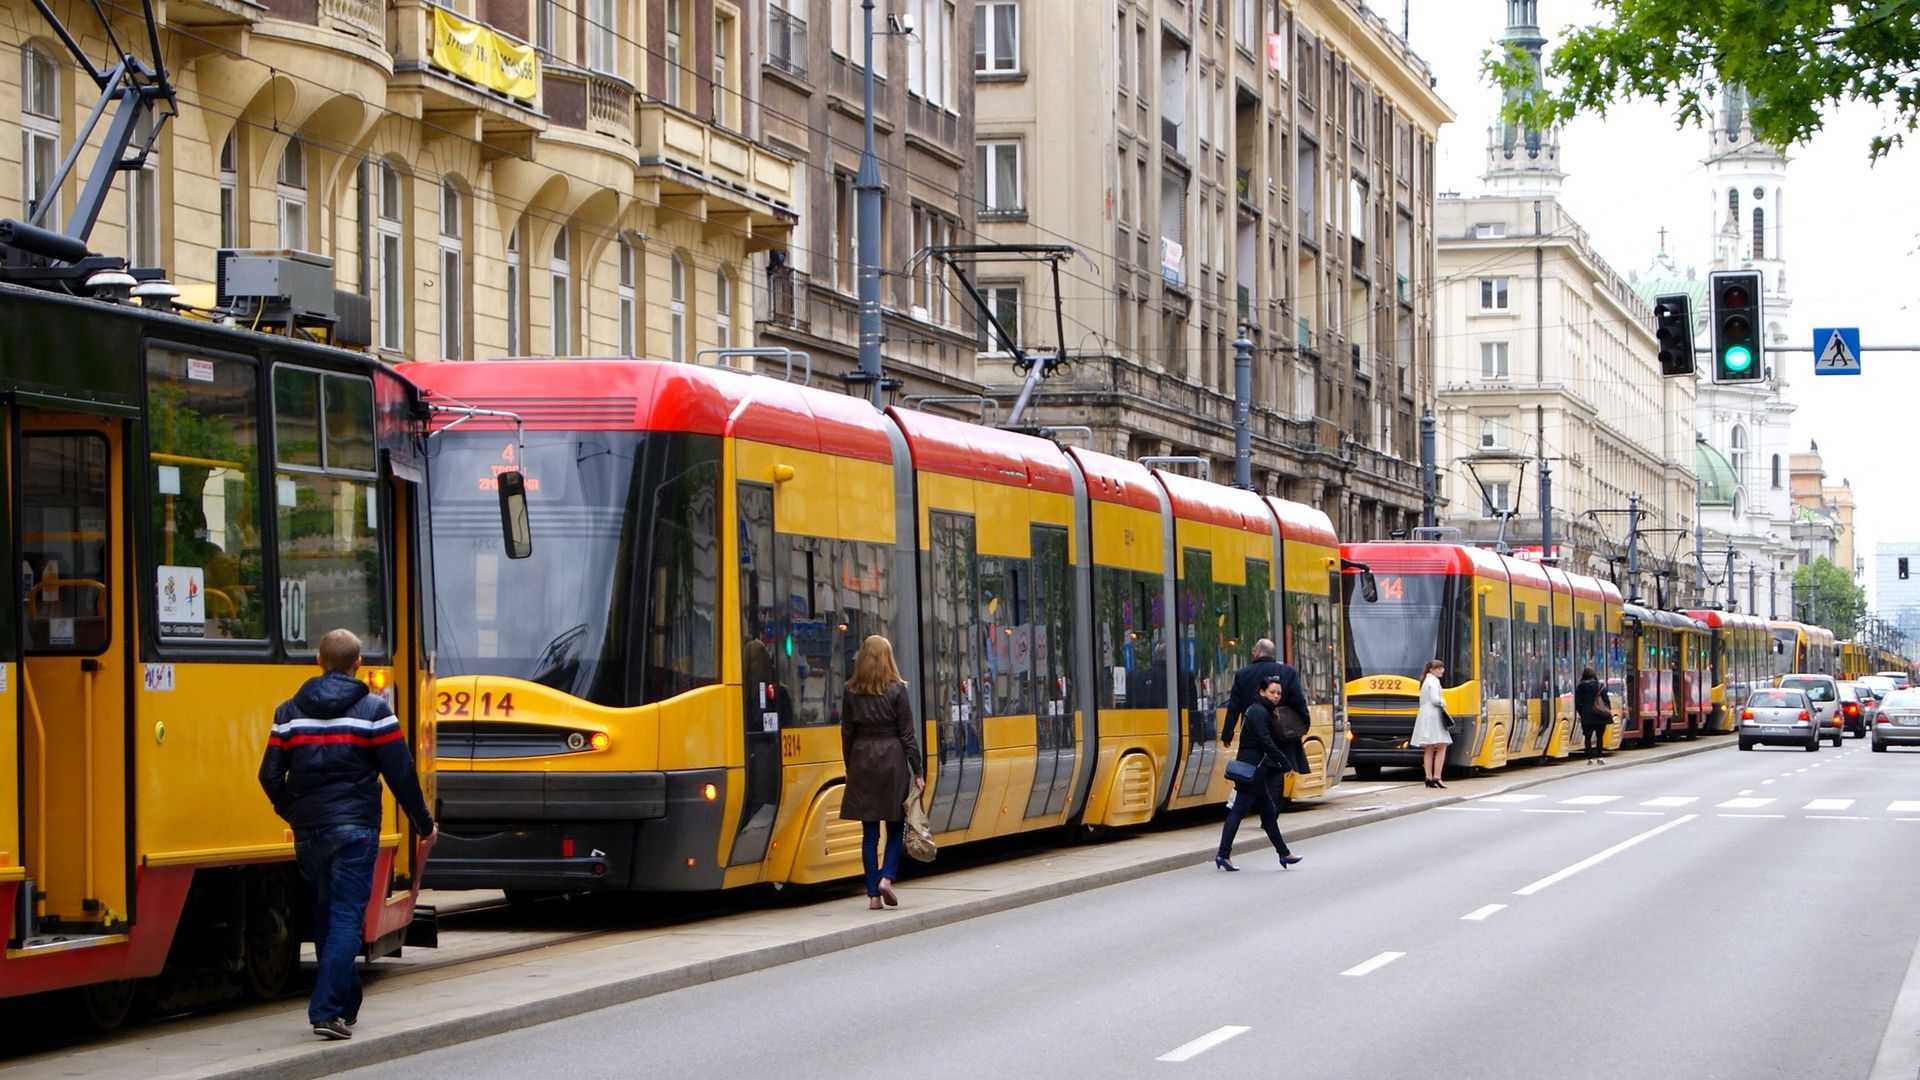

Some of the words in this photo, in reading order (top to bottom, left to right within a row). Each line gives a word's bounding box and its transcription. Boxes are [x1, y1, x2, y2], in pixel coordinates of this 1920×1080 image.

[502, 443, 514, 463] 4
[1381, 577, 1403, 600] 14
[283, 581, 300, 639] 10
[1370, 679, 1402, 690] 3222
[436, 691, 514, 717] 3214
